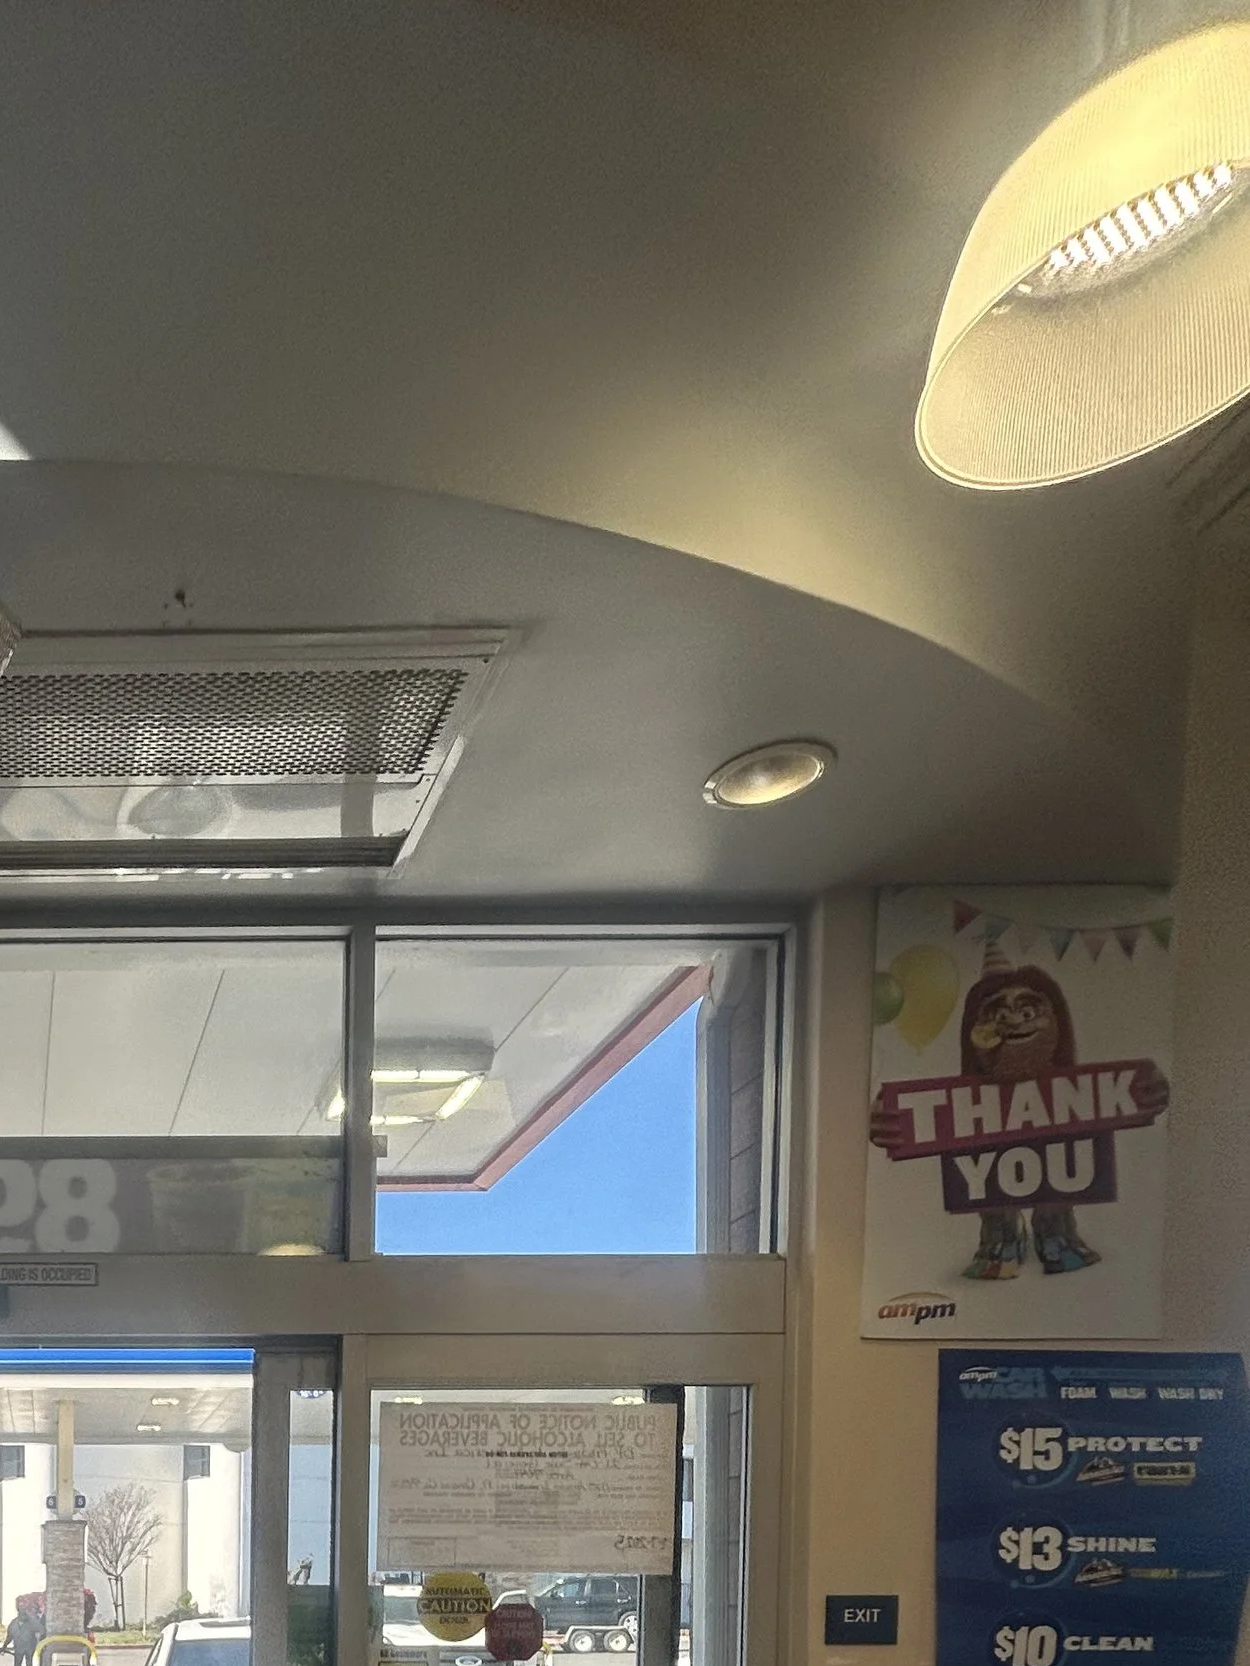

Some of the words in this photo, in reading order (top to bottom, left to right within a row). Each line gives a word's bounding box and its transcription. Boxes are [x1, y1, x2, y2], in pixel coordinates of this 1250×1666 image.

[898, 1070, 1138, 1144] THANK
[953, 1138, 1094, 1200] YOU
[29, 1267, 38, 1282] IS
[41, 1267, 93, 1282] OCCUPIED
[878, 1299, 956, 1325] ampm
[999, 1427, 1063, 1471] $15
[1067, 1436, 1202, 1453] PROTECT
[998, 1527, 1062, 1572] $13
[1067, 1537, 1157, 1553] SHINE
[843, 1608, 881, 1624] EXIT
[1063, 1636, 1154, 1652] CLEAN
